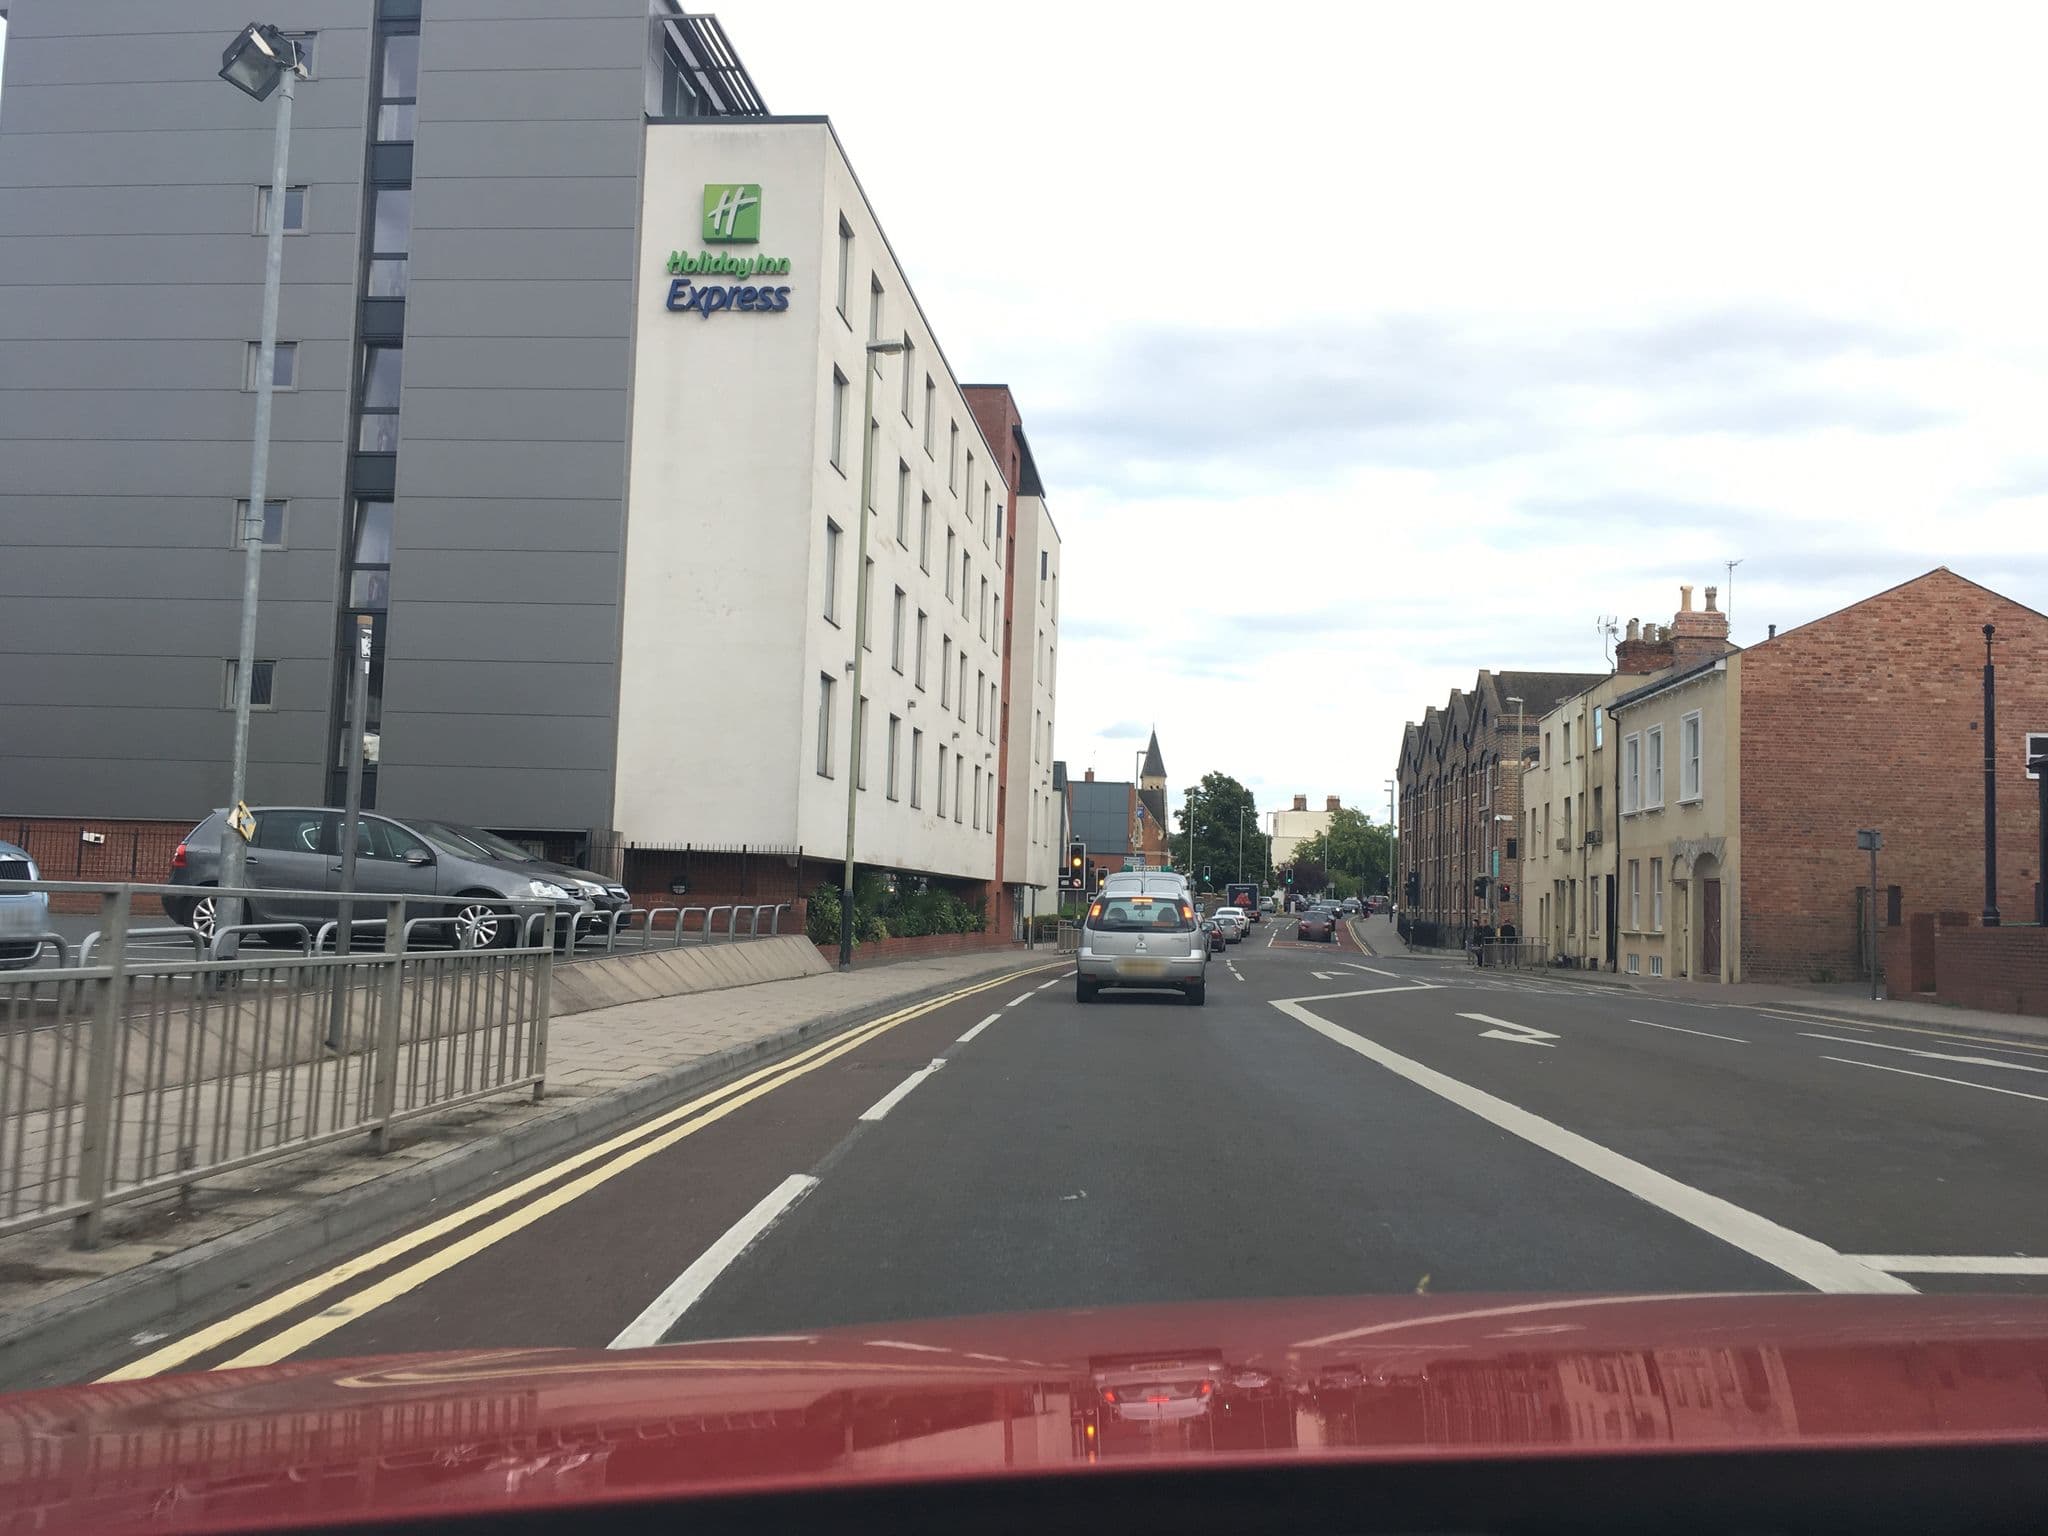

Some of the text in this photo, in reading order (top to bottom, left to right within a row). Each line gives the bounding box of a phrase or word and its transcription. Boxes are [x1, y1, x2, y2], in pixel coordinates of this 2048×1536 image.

[708, 186, 758, 236] H
[666, 250, 791, 280] Holiday Inn
[665, 278, 791, 319] Express
